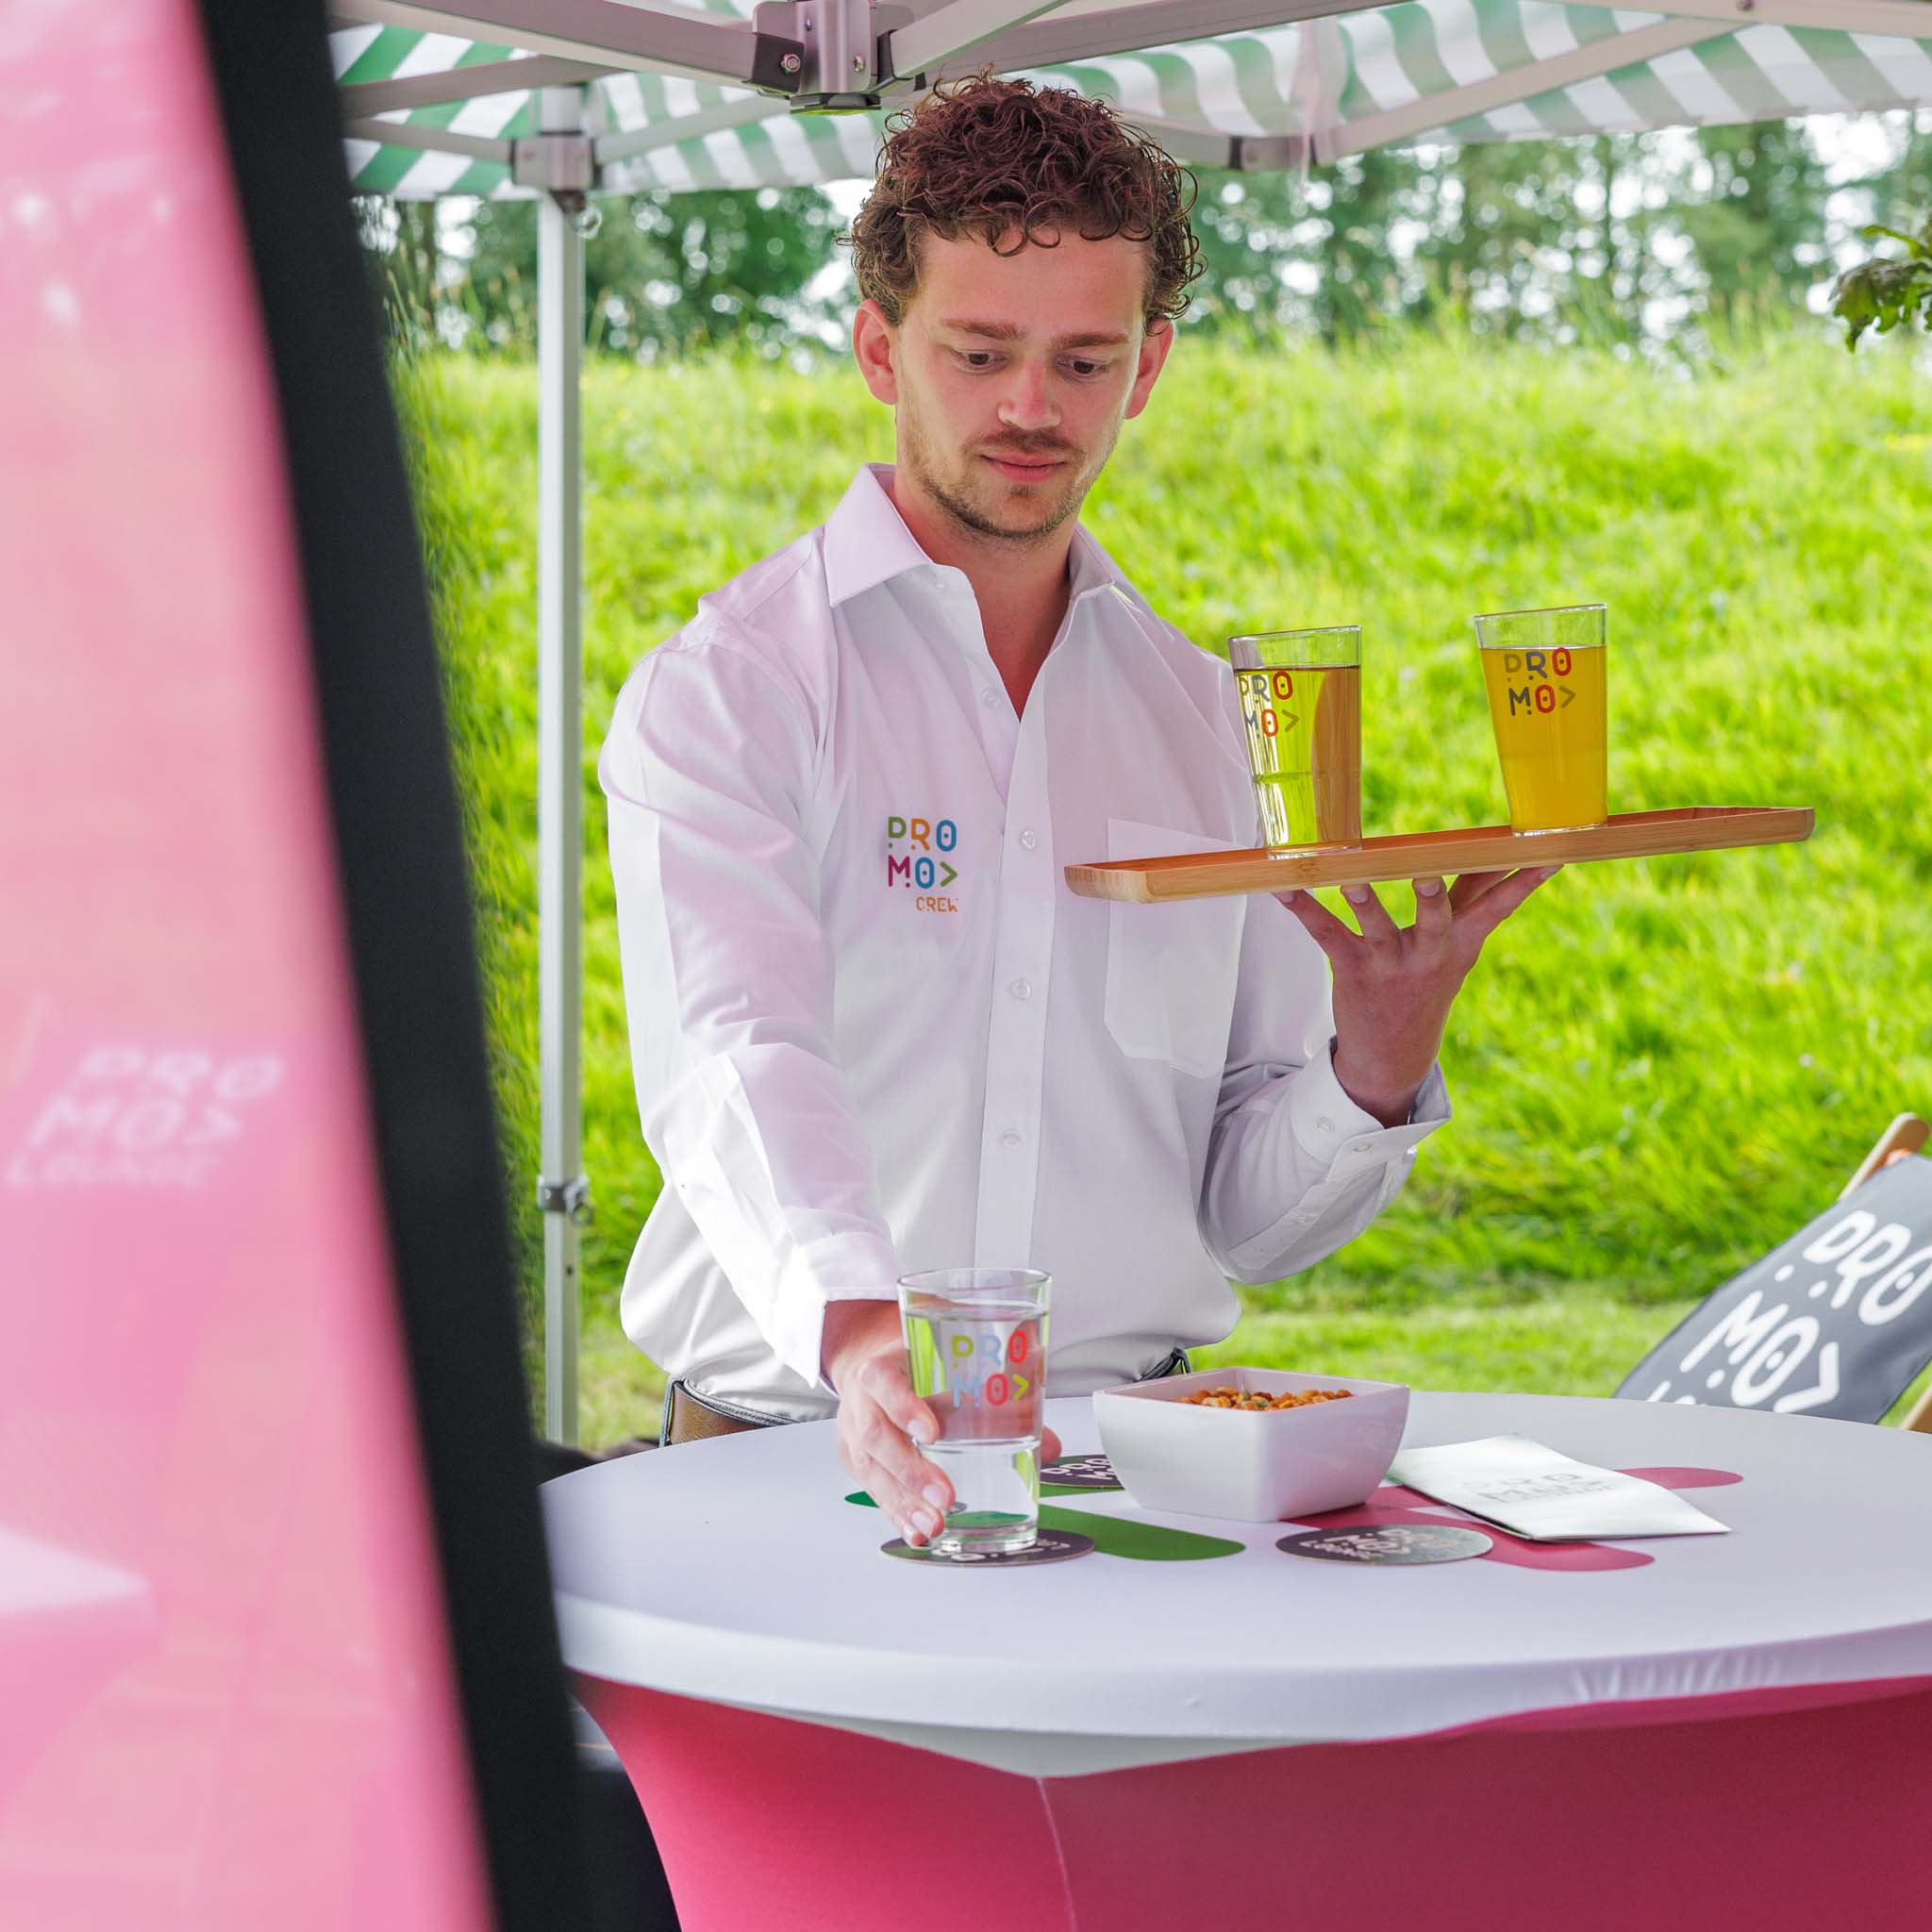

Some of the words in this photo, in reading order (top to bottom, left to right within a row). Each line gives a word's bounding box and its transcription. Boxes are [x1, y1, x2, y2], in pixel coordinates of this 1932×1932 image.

[1504, 647, 1572, 682] PRO
[1238, 670, 1294, 704] PRO
[888, 816, 957, 852] PRO
[1774, 1209, 1932, 1325] PRO
[951, 1330, 1027, 1370] PRO
